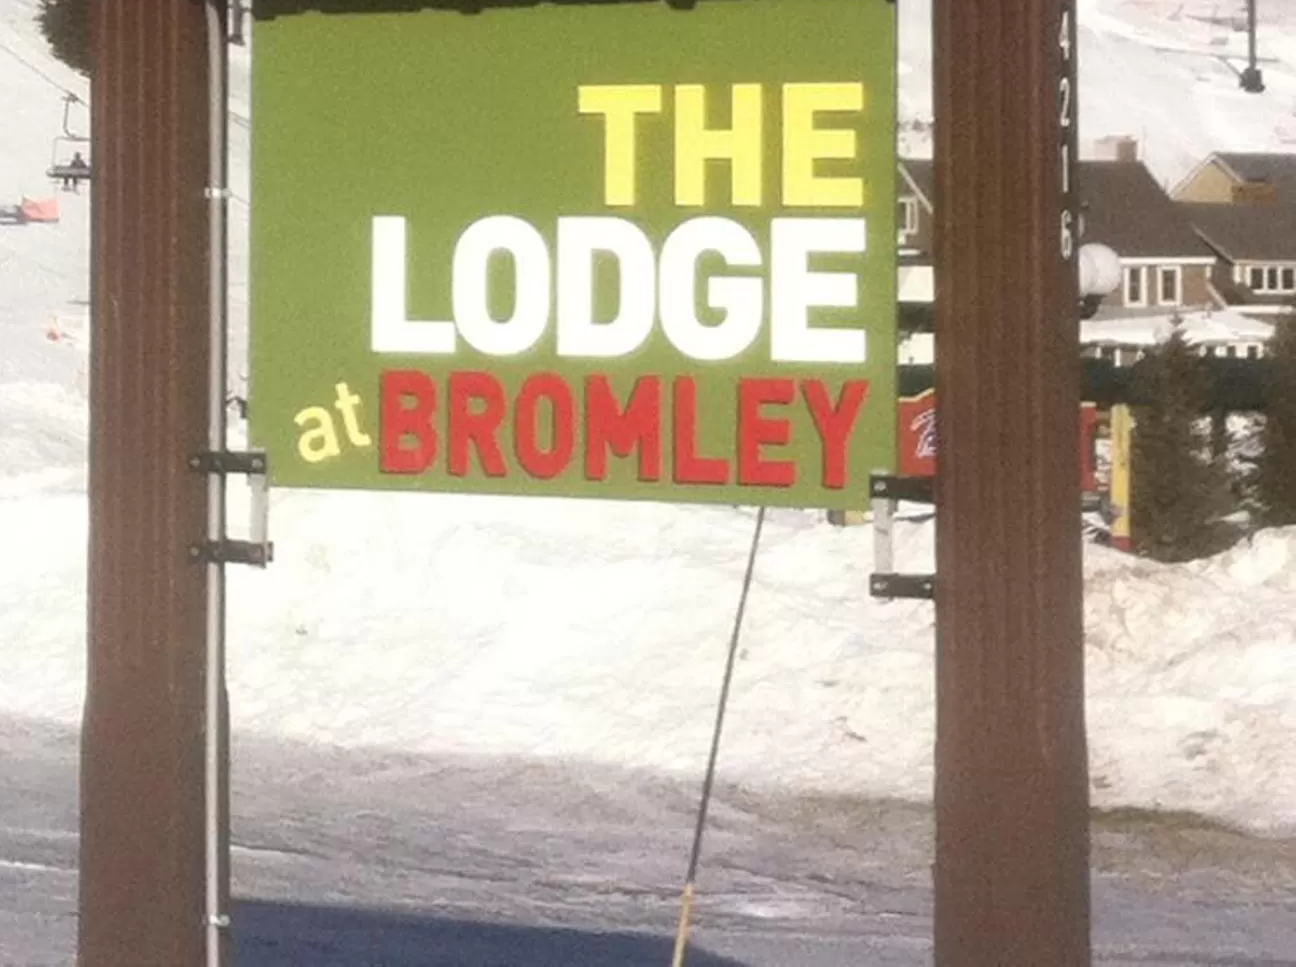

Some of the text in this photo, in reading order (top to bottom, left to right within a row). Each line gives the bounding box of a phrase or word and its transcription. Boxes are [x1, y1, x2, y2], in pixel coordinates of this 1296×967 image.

[577, 82, 865, 207] THE
[1058, 10, 1074, 261] 4216
[371, 215, 867, 363] LODGE
[293, 381, 373, 463] at
[379, 368, 869, 490] BROMLEY
